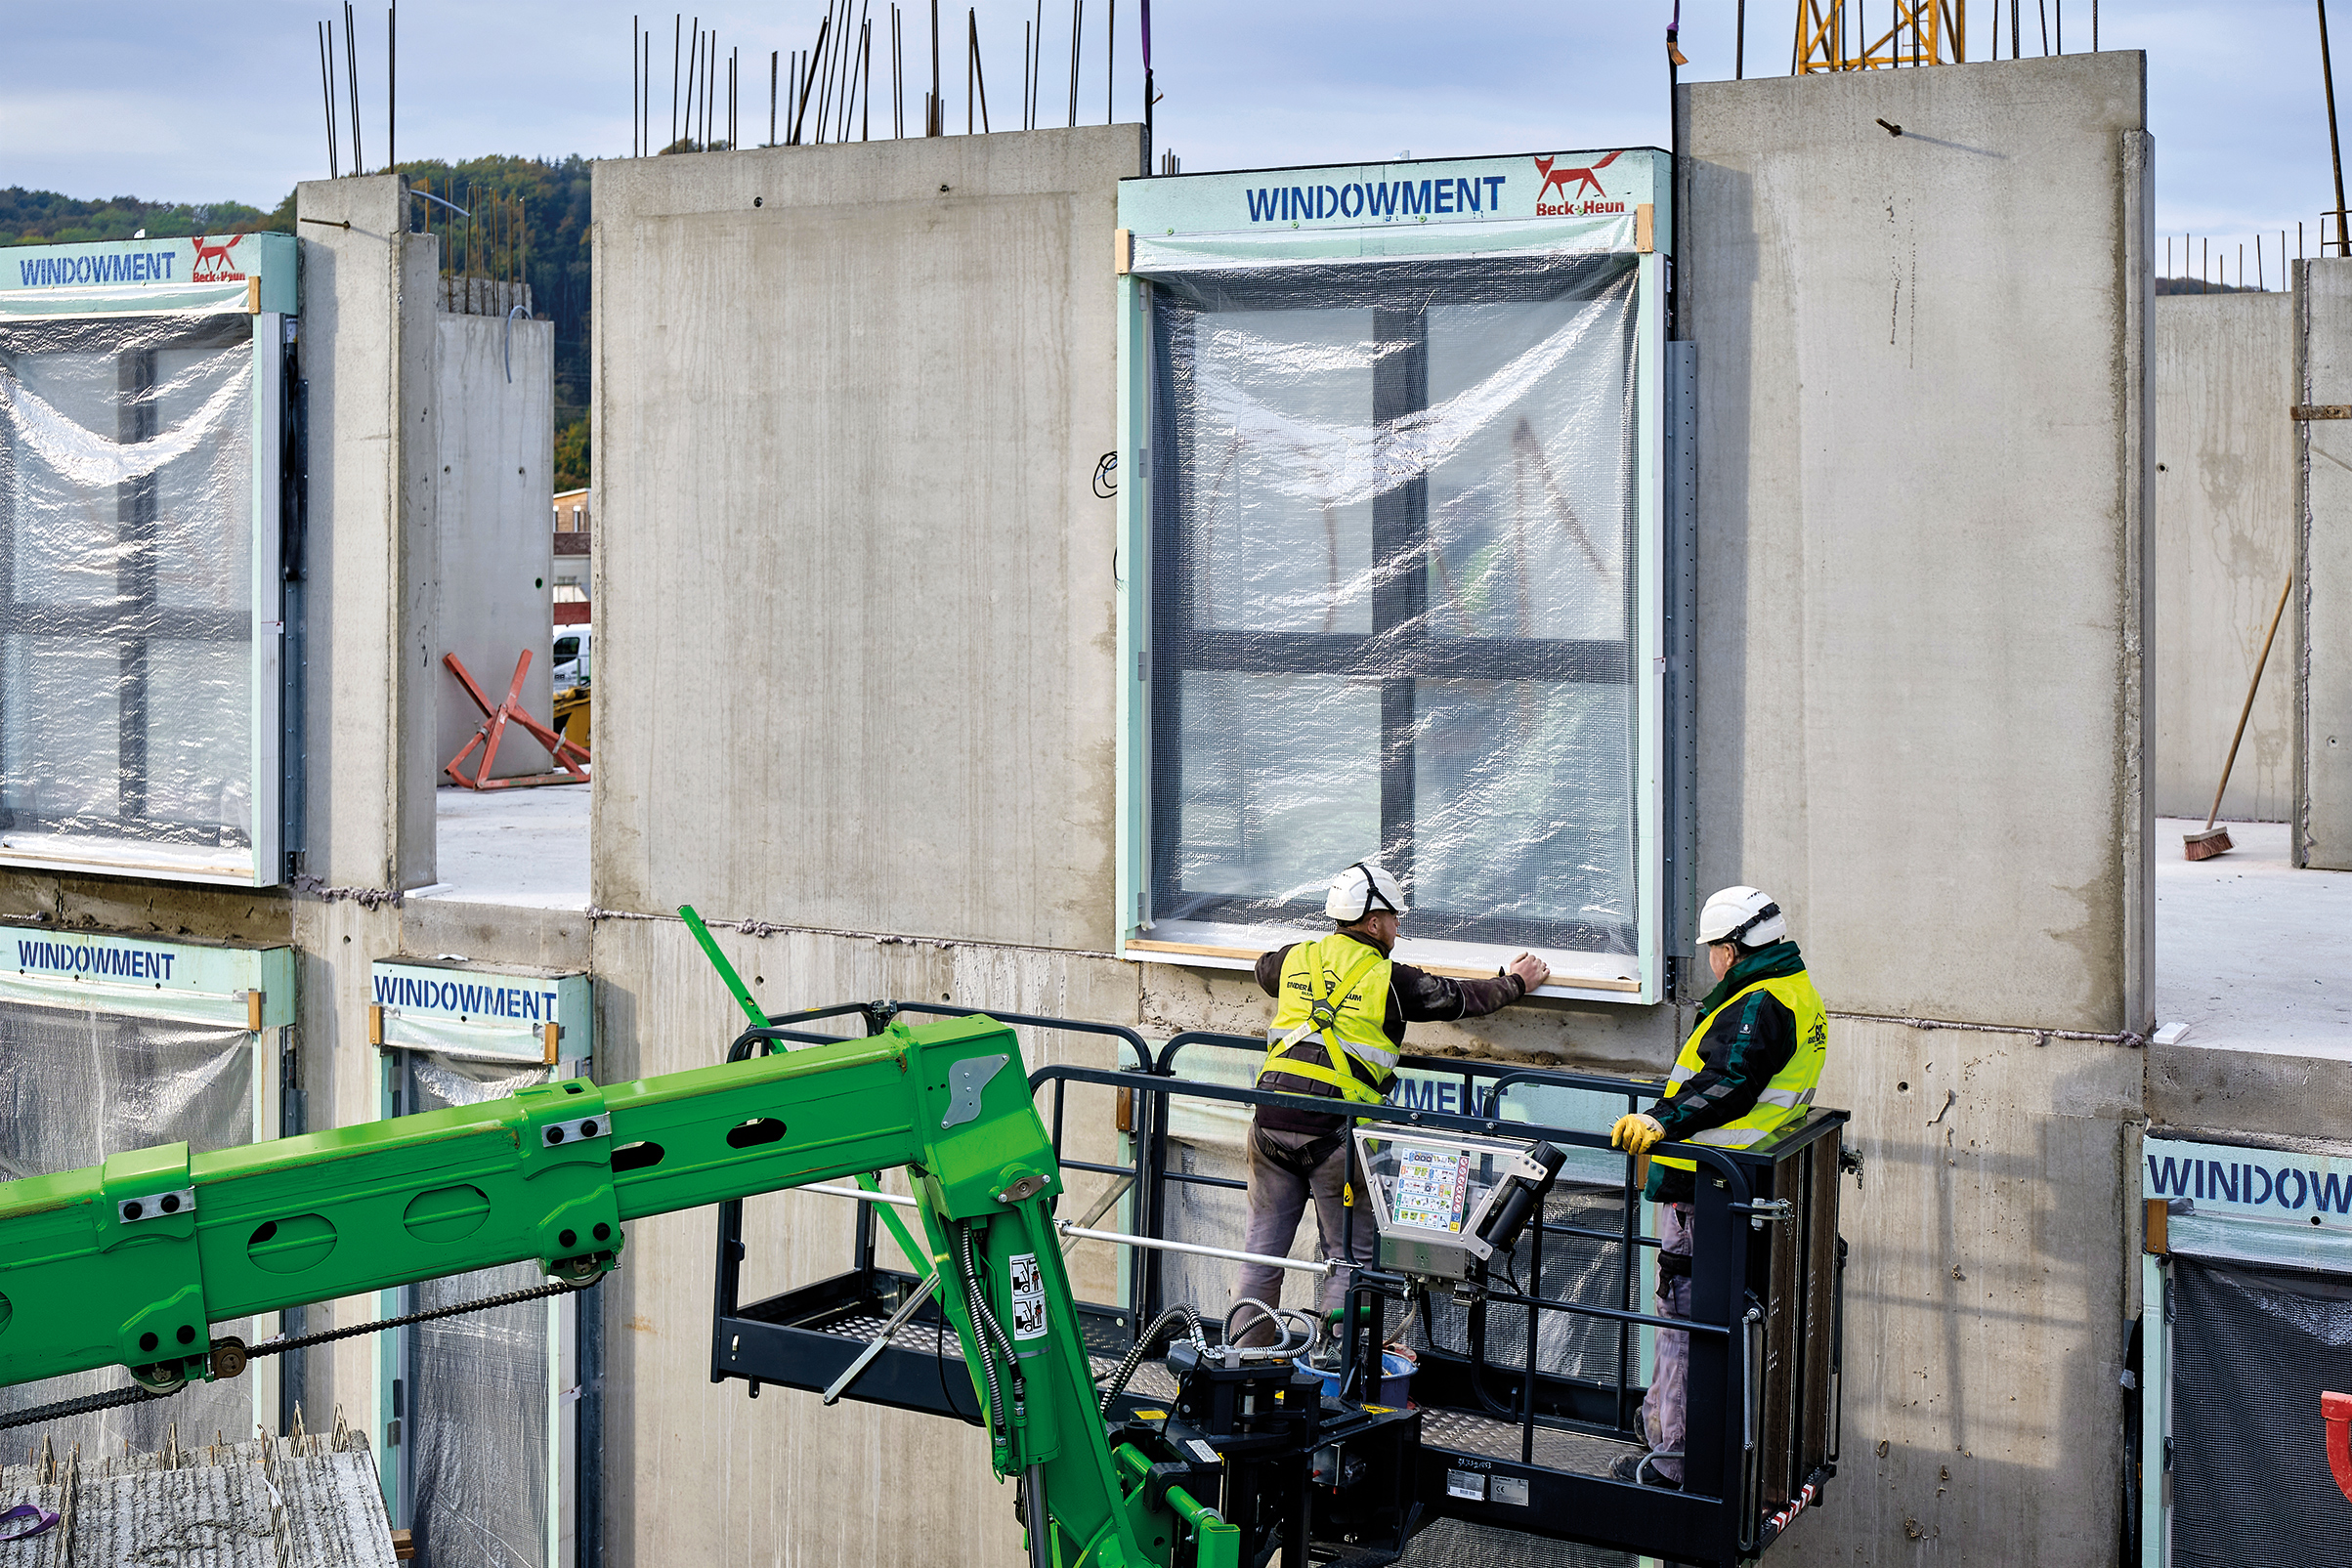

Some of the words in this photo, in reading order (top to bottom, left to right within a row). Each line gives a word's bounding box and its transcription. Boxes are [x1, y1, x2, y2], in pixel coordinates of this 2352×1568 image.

[1246, 176, 1506, 223] WINDOWMENT
[20, 251, 176, 286] WINDOWMENT
[18, 940, 175, 980] WINDOWMENT
[373, 975, 557, 1021] WINDOWMENT
[2147, 1154, 2352, 1214] WINDOW
